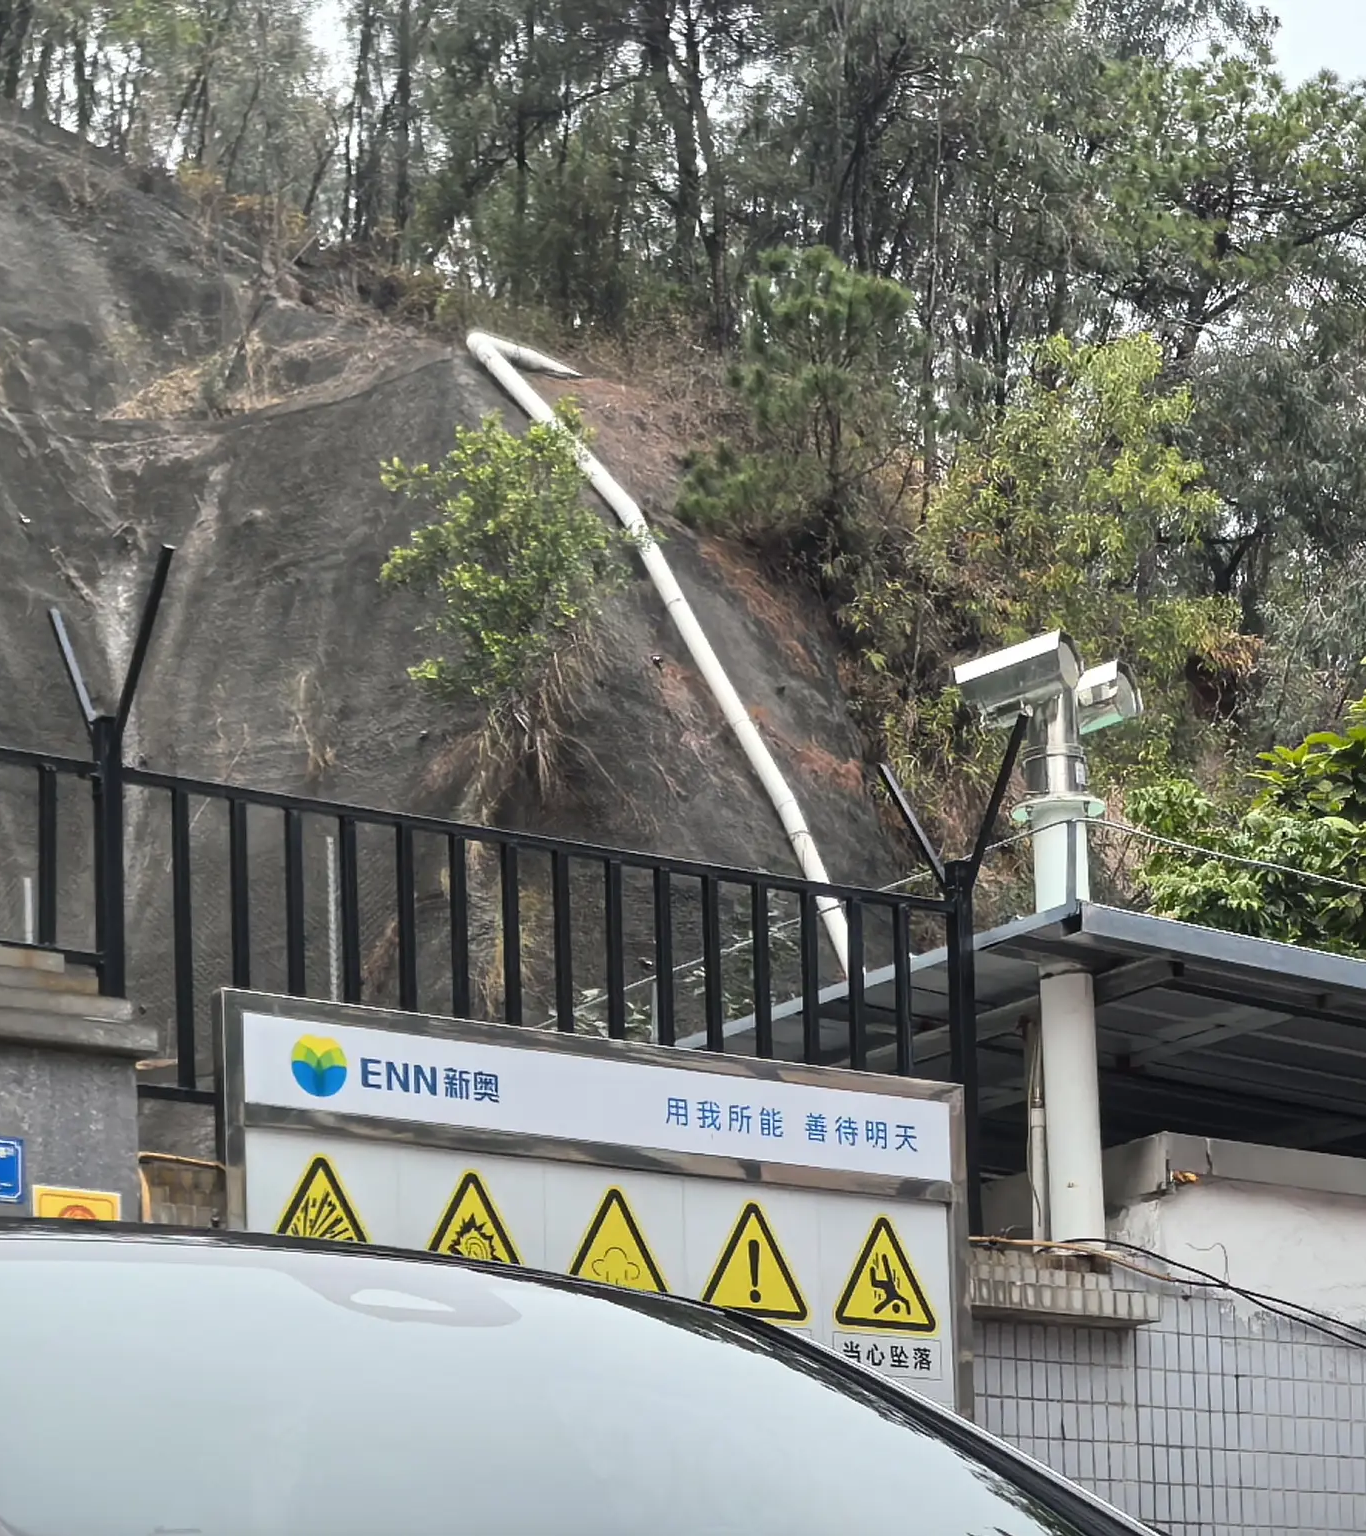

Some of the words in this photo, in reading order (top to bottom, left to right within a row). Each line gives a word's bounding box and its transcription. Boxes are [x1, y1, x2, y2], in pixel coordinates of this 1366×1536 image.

[666, 1097, 784, 1138] 用我所能
[804, 1112, 918, 1152] 善待明天
[842, 1340, 933, 1372] 当心坠落
